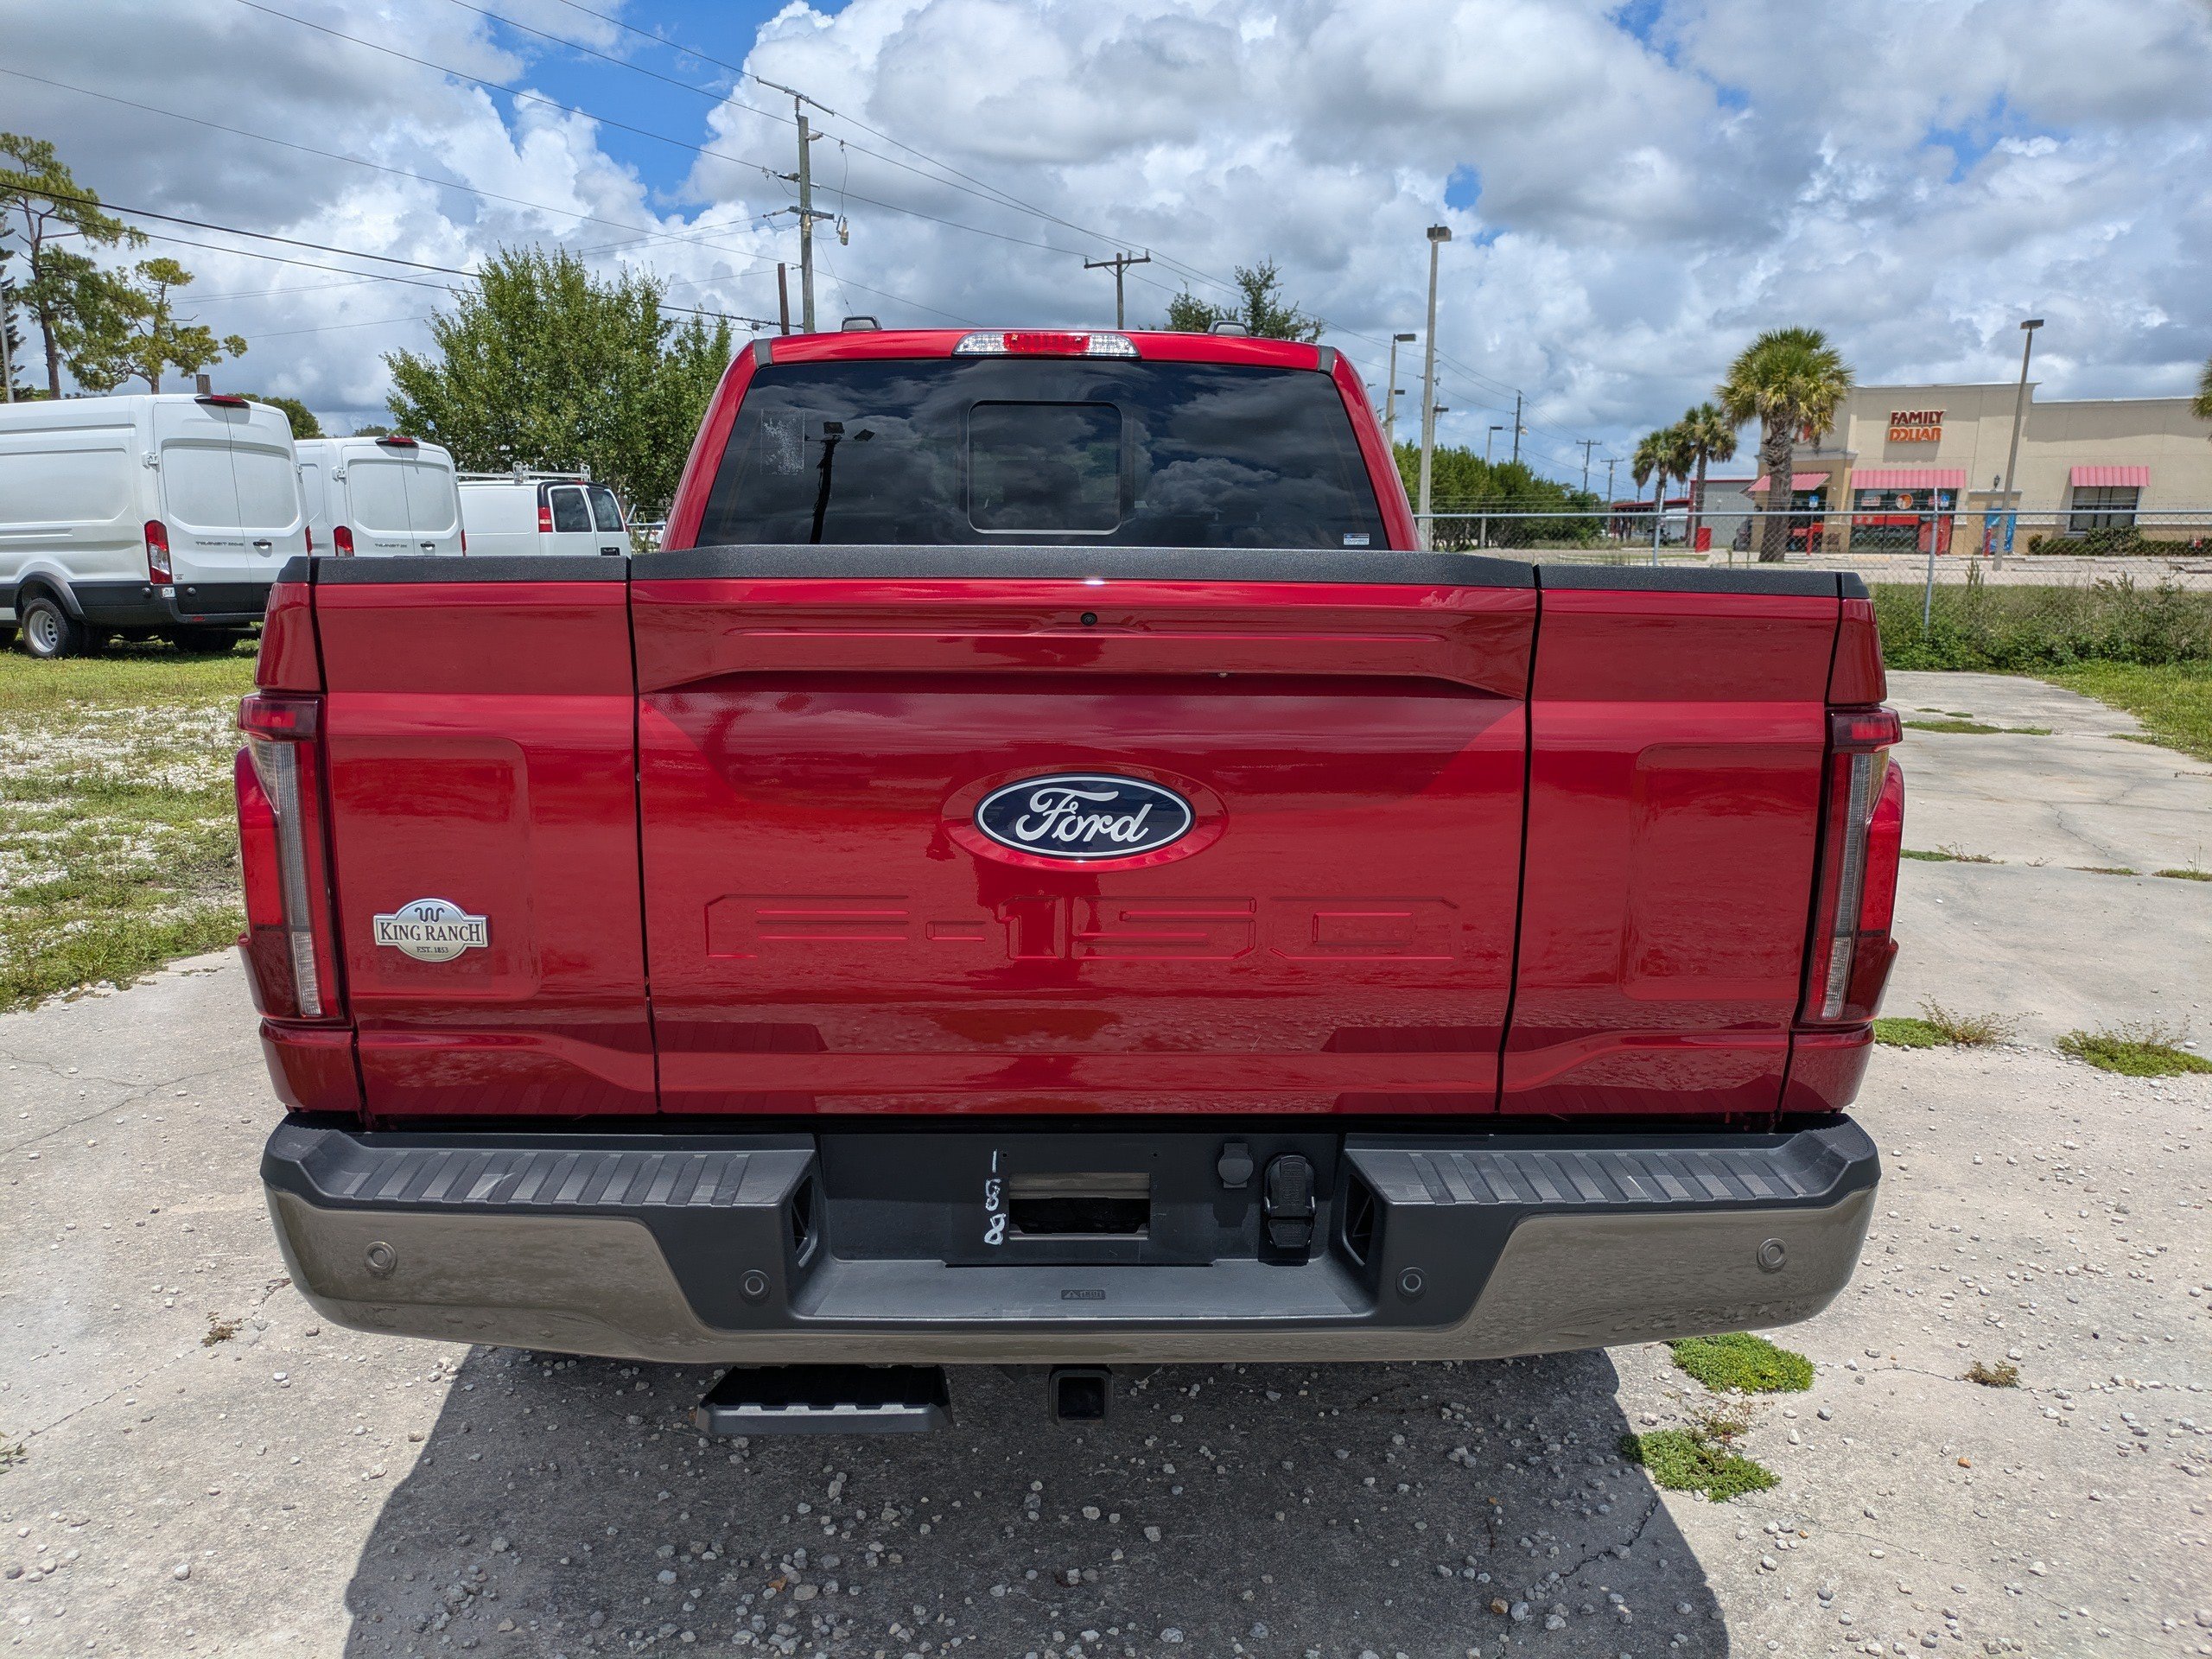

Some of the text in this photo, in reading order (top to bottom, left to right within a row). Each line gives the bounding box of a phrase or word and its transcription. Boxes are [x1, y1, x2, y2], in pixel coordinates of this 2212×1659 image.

[1891, 410, 1945, 424] FAMILY
[1889, 427, 1942, 442] DOLLAR
[1015, 787, 1153, 842] Ford
[380, 922, 481, 942] KING RANCH
[703, 894, 1459, 963] F-150
